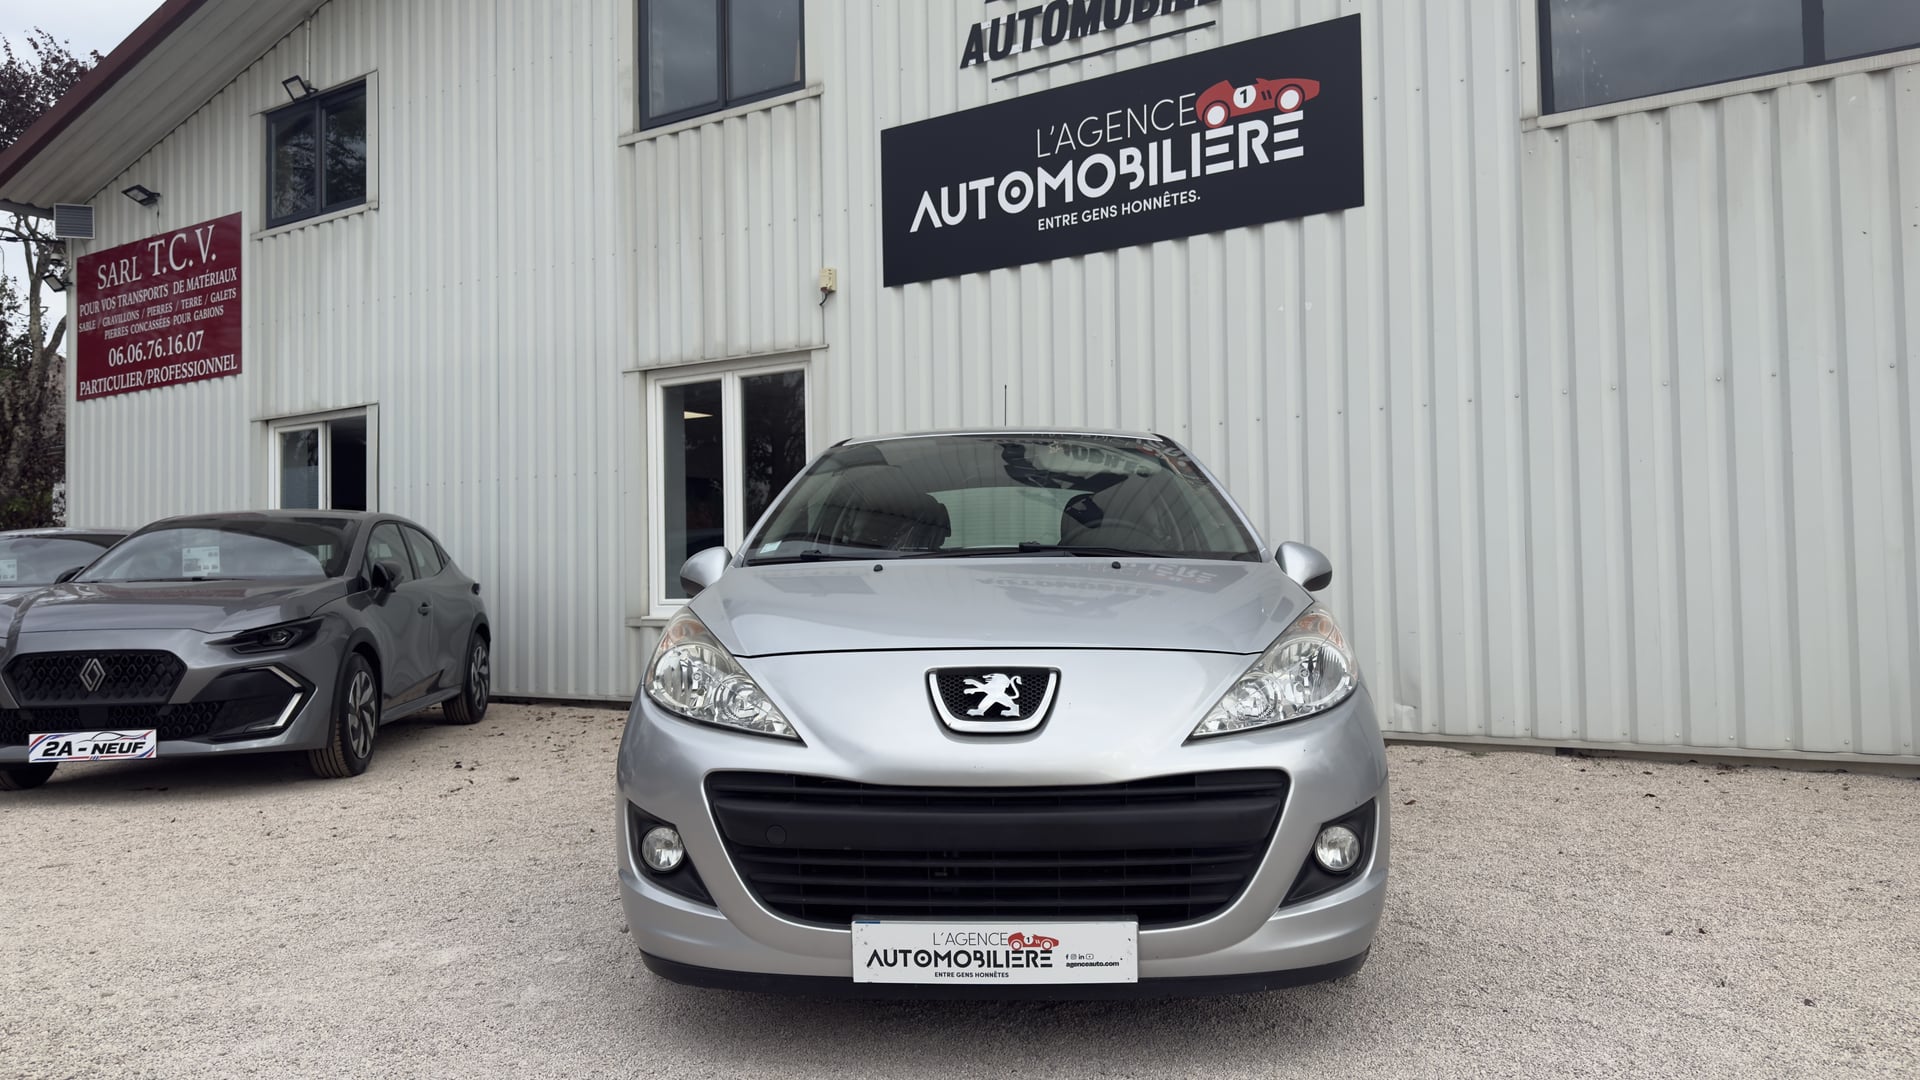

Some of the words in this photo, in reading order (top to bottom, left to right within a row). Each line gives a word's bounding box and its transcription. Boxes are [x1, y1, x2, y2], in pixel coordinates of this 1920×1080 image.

[1239, 88, 1249, 104] 1
[1036, 92, 1197, 159] L'AGENCE
[1037, 212, 1079, 231] ENTRE
[1081, 204, 1118, 223] GENS
[1121, 189, 1201, 216] HONNÊTES.
[97, 256, 143, 290] SARL
[79, 301, 100, 317] POUR
[101, 296, 117, 312] VOS
[117, 284, 169, 308] TRANSPORTS
[173, 280, 185, 295] DE
[186, 268, 237, 292] MATÉRIAUX
[79, 320, 96, 333] SABLE
[102, 310, 140, 327] GRAVILLONS
[147, 303, 173, 317] PIERRES
[181, 295, 203, 310] TERRE
[210, 288, 237, 303] GALETS
[104, 326, 129, 340] PIERRES
[130, 315, 171, 334] CONCASSÉES
[173, 312, 192, 326] POUR
[193, 305, 224, 321] GABIONS
[108, 330, 205, 368] 06.06.76.16.07
[79, 353, 238, 397] PARTICULIER/PROFESSIONNEL
[42, 741, 73, 757] 2A
[90, 742, 146, 755] NEUF
[933, 932, 1008, 946] L'AGENCE
[975, 970, 1010, 978] HONNÊTES
[1065, 961, 1120, 969] agenceauto.com
